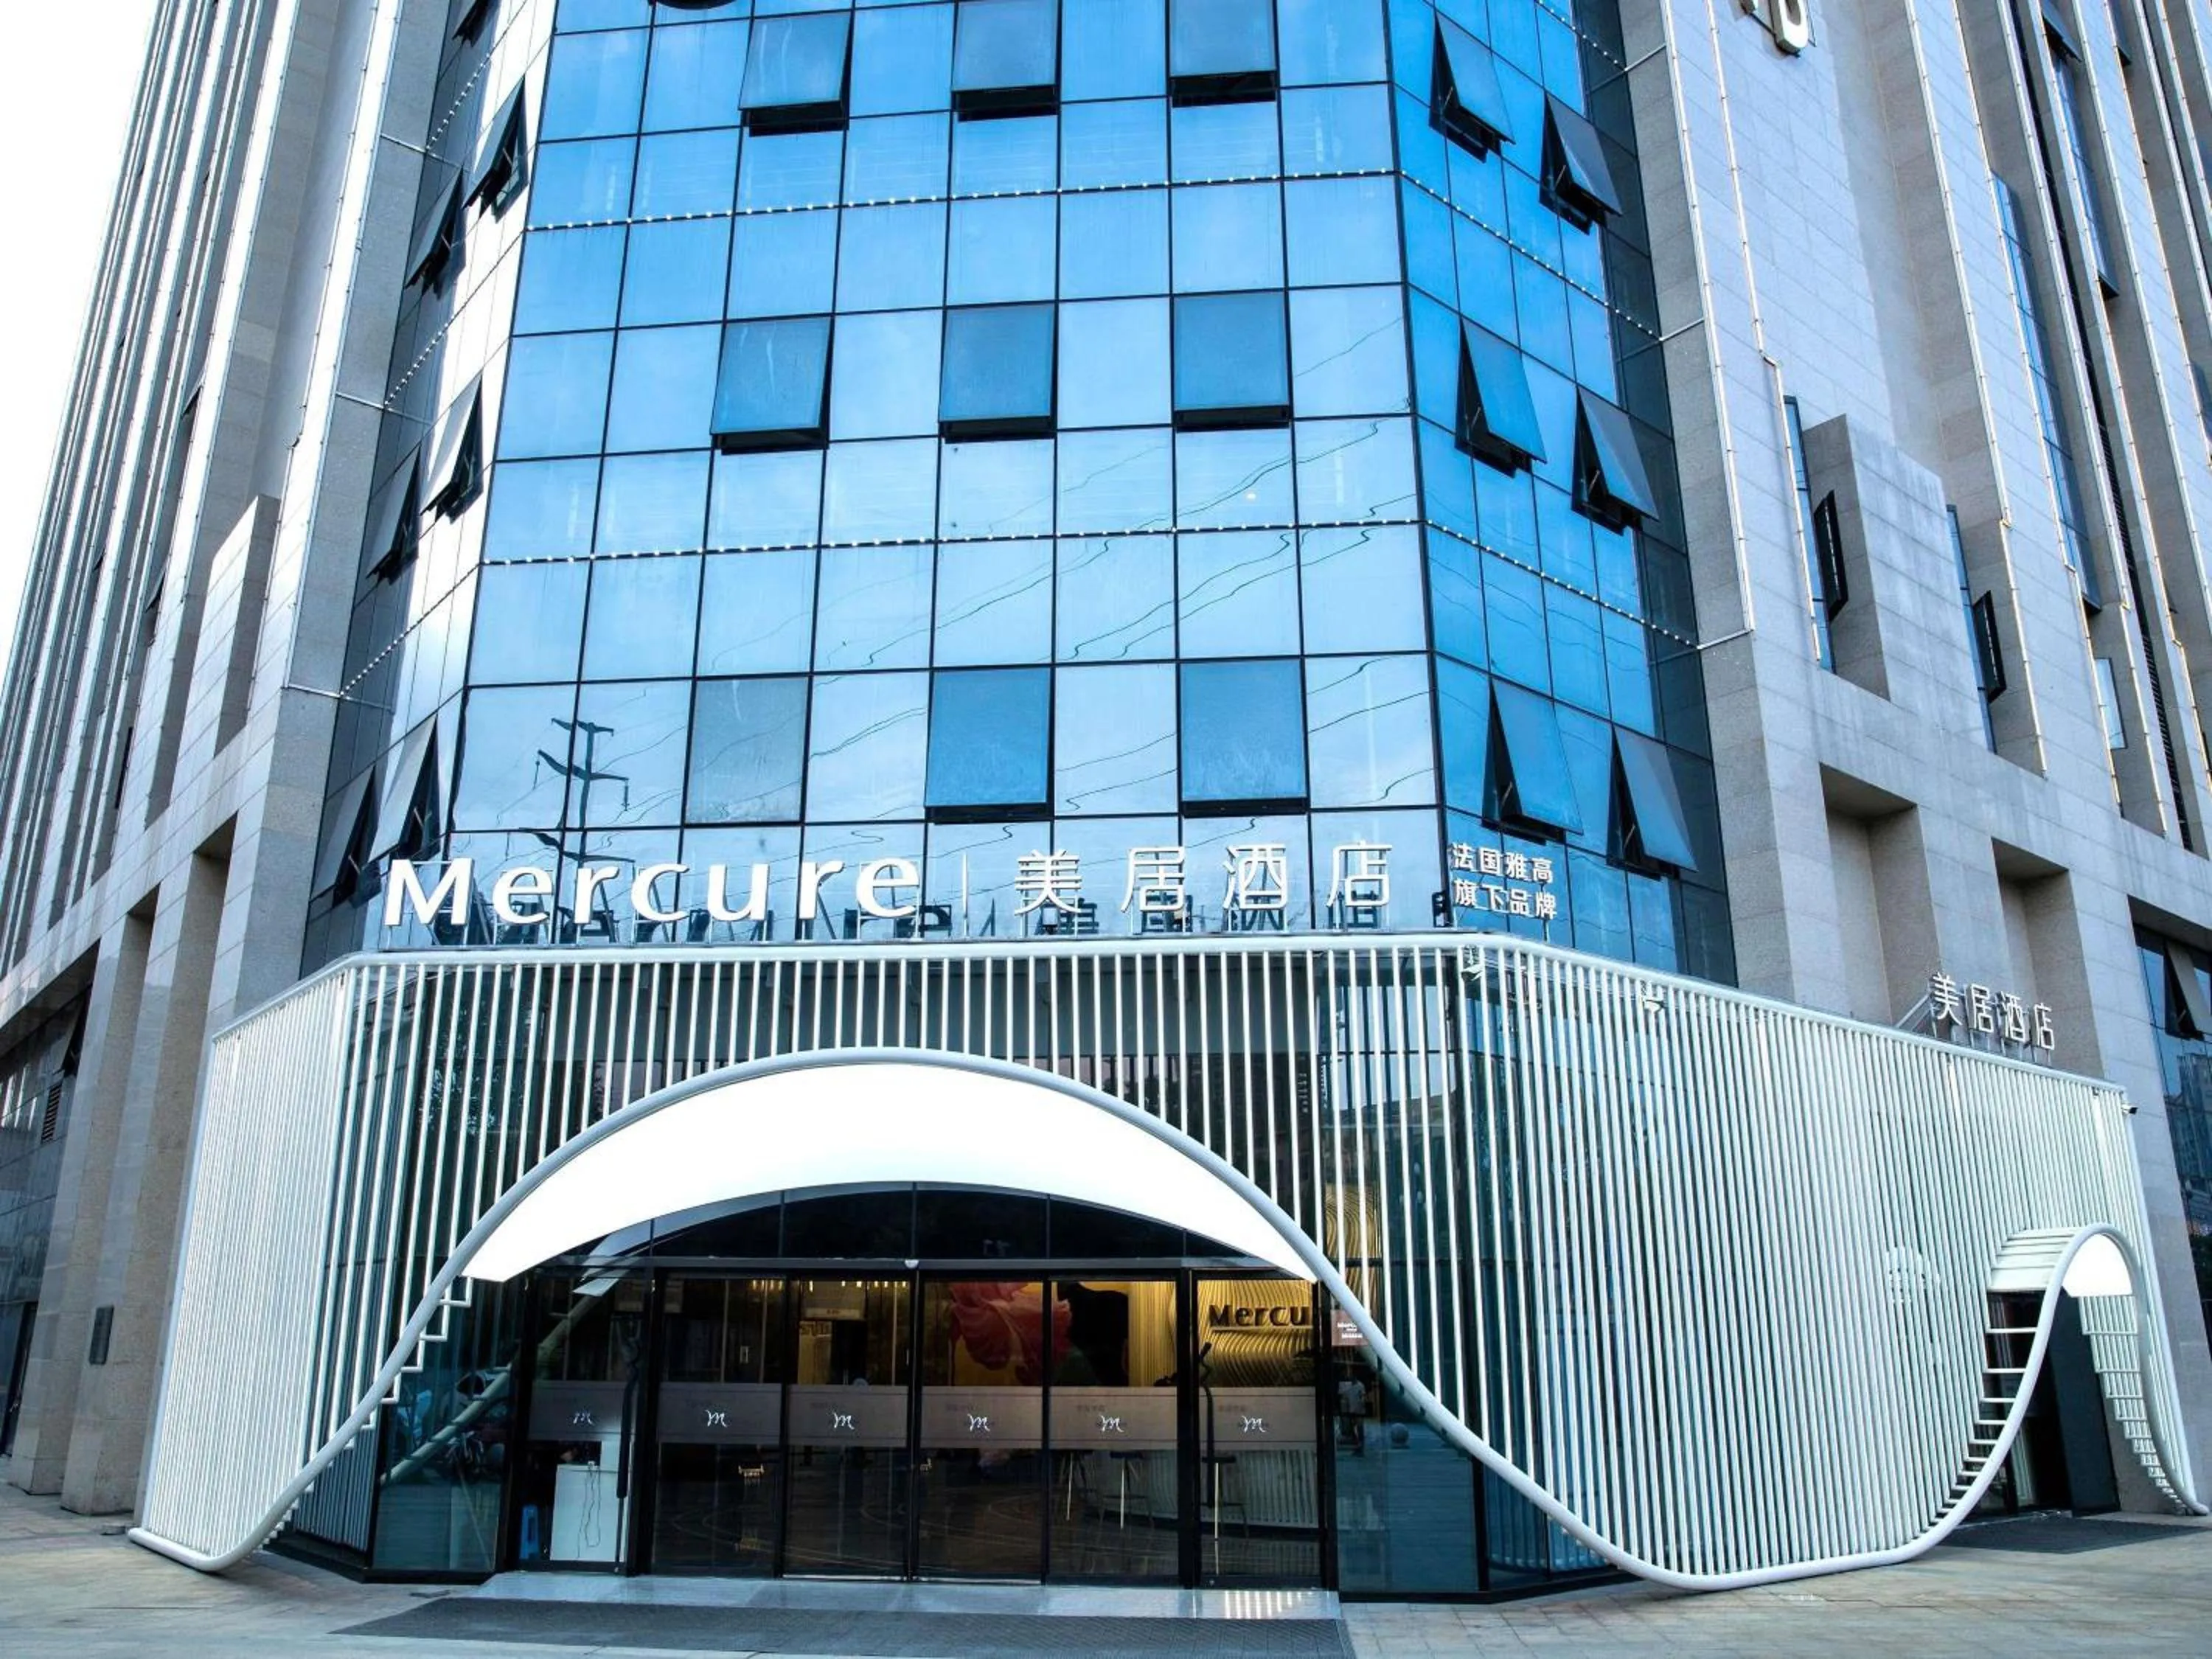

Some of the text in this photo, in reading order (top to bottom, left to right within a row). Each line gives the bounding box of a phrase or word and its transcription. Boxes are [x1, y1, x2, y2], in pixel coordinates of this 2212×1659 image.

[383, 856, 922, 927] Mercure
[1015, 840, 1393, 915] 美居酒店
[1451, 842, 1554, 883] 法国雅高
[1454, 878, 1557, 919] 旗下品牌
[1929, 972, 2055, 1051] 美居酒店
